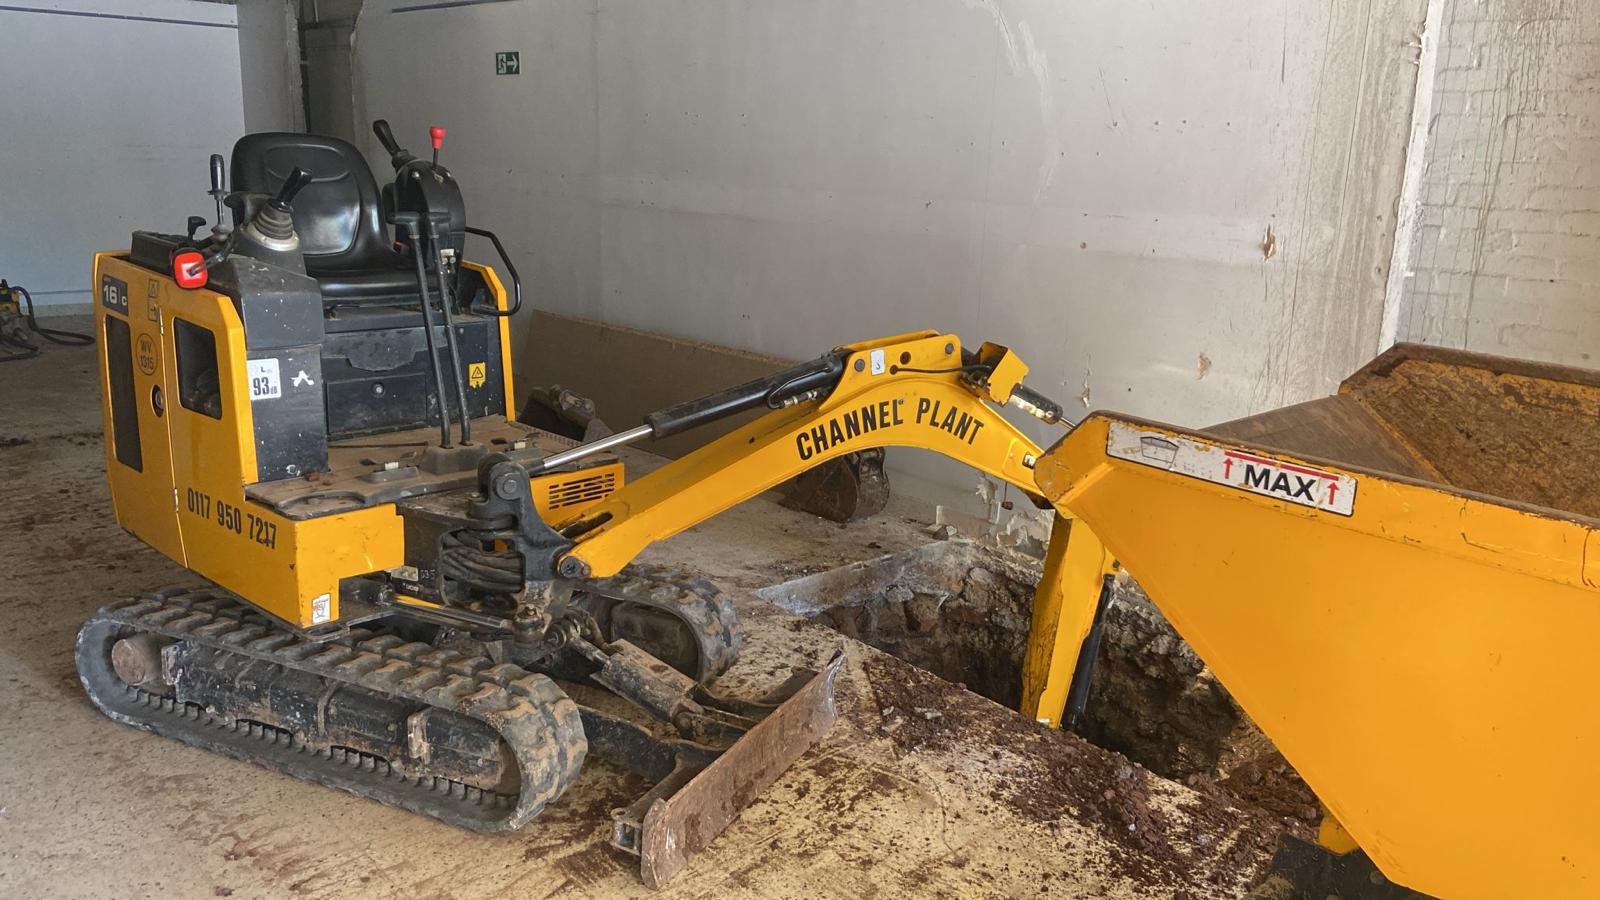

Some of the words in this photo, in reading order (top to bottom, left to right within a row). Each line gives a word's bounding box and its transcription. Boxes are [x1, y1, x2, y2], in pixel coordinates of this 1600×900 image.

[104, 285, 117, 304] 16
[253, 376, 270, 395] 93
[796, 399, 904, 460] CHANNEL
[916, 398, 984, 445] PLANT
[1244, 464, 1317, 502] MAX
[187, 487, 211, 520] 0117
[217, 500, 242, 534] 950
[247, 513, 277, 549] 7217
